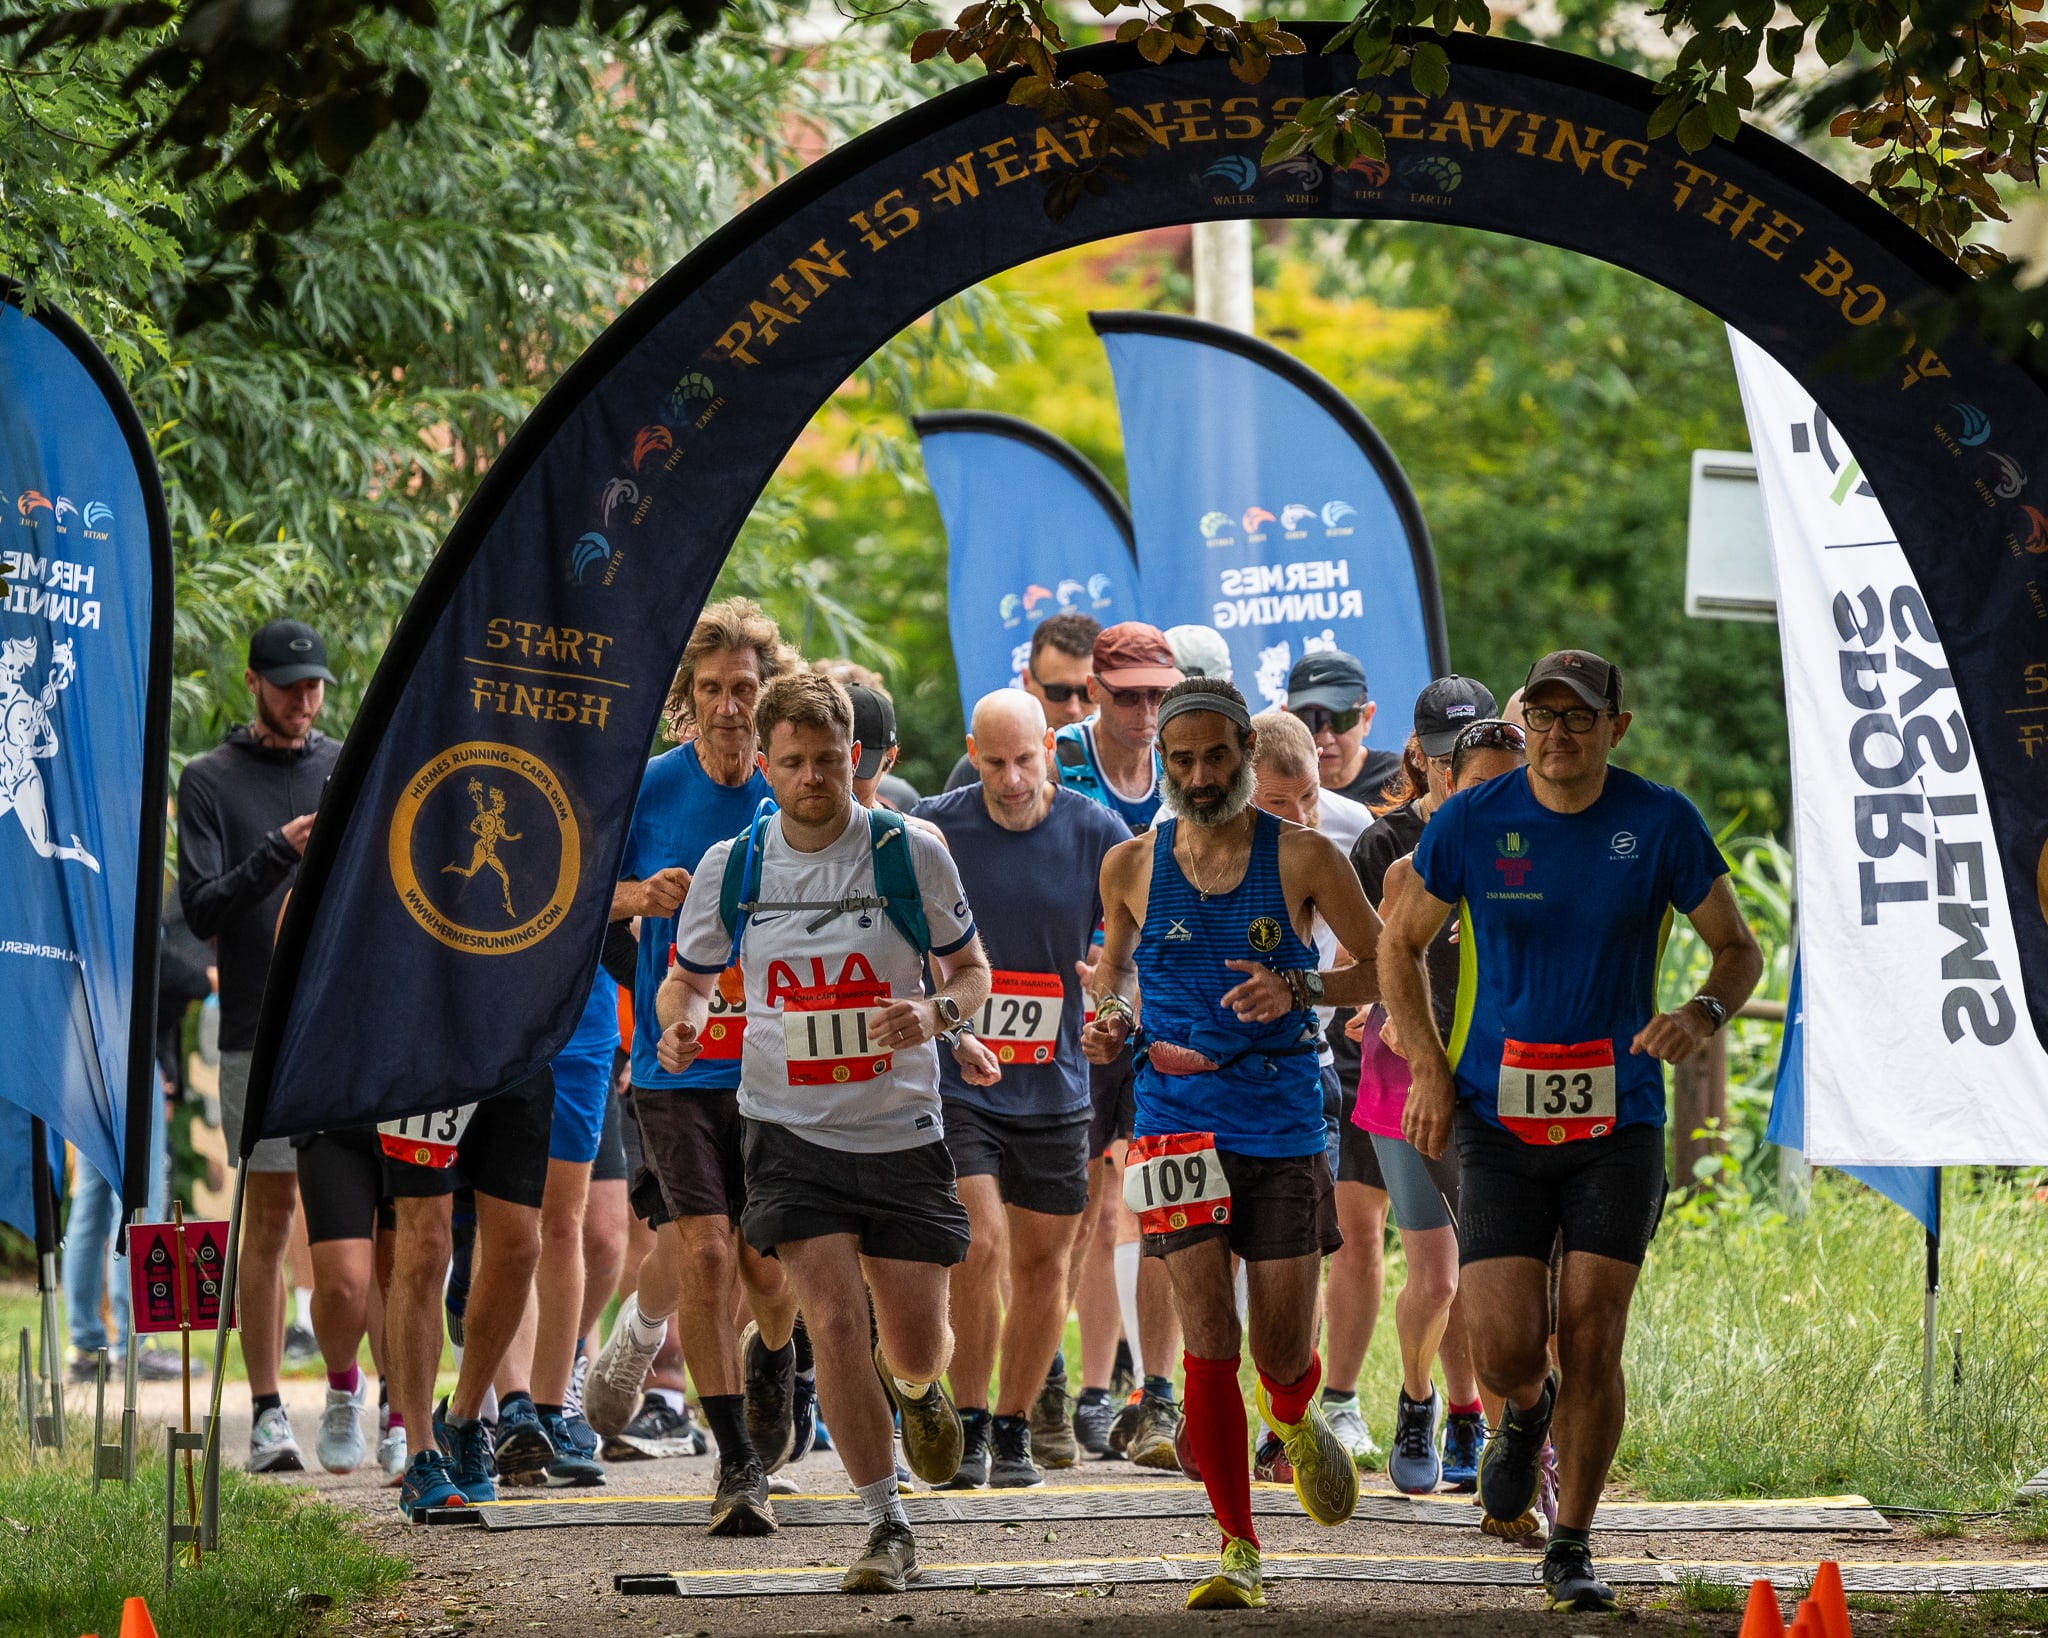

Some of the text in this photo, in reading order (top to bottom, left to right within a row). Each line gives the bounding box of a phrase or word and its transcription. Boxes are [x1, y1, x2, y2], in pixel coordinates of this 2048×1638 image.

[1213, 194, 1256, 206] WATER
[1285, 193, 1320, 205] WIND
[1354, 190, 1384, 200] FIRE
[1410, 193, 1453, 207] EARTH
[715, 238, 853, 364] PAIN
[849, 189, 920, 254] IS
[1344, 96, 1649, 190] EAVING
[1673, 159, 1805, 262] THE
[1800, 246, 1952, 391] BOY
[695, 396, 727, 431] EARTH
[1933, 422, 1963, 458] WATER
[663, 445, 687, 473] FIRE
[631, 495, 654, 526] WIND
[1973, 477, 1997, 509] WIND
[2005, 533, 2025, 561] FIRE
[602, 550, 625, 587] WATER
[2025, 579, 2048, 620] EARTH
[486, 617, 614, 669] START
[470, 676, 613, 732] FINISH
[411, 758, 451, 800] HERMES
[550, 789, 569, 821] DIEM
[1506, 832, 1520, 851] 100
[1499, 891, 1543, 901] MARATHONS
[405, 888, 564, 948] WWW.HERMESRUNNING.COM
[766, 952, 879, 1008] AIA
[806, 1011, 868, 1057] 111
[982, 997, 1043, 1038] 129
[1526, 1072, 1594, 1115] 133
[1142, 1155, 1207, 1207] 109
